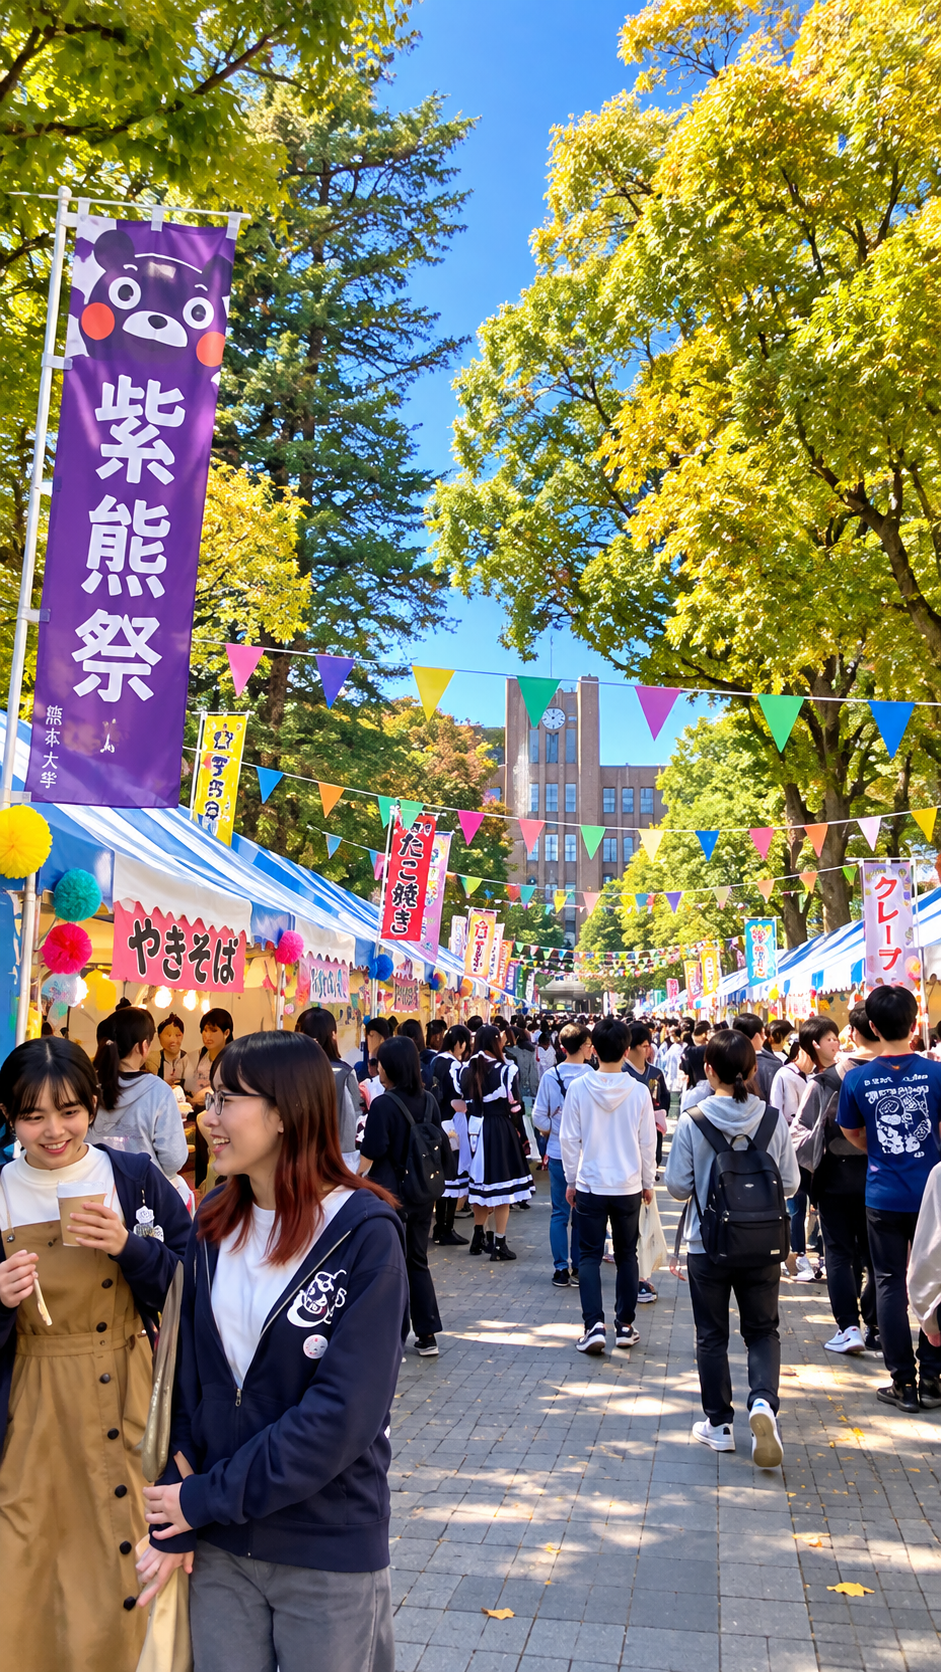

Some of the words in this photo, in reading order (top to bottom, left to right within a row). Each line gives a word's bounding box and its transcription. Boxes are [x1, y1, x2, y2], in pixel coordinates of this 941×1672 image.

[71, 374, 185, 703] 紫熊祭
[128, 917, 239, 985] やきそば
